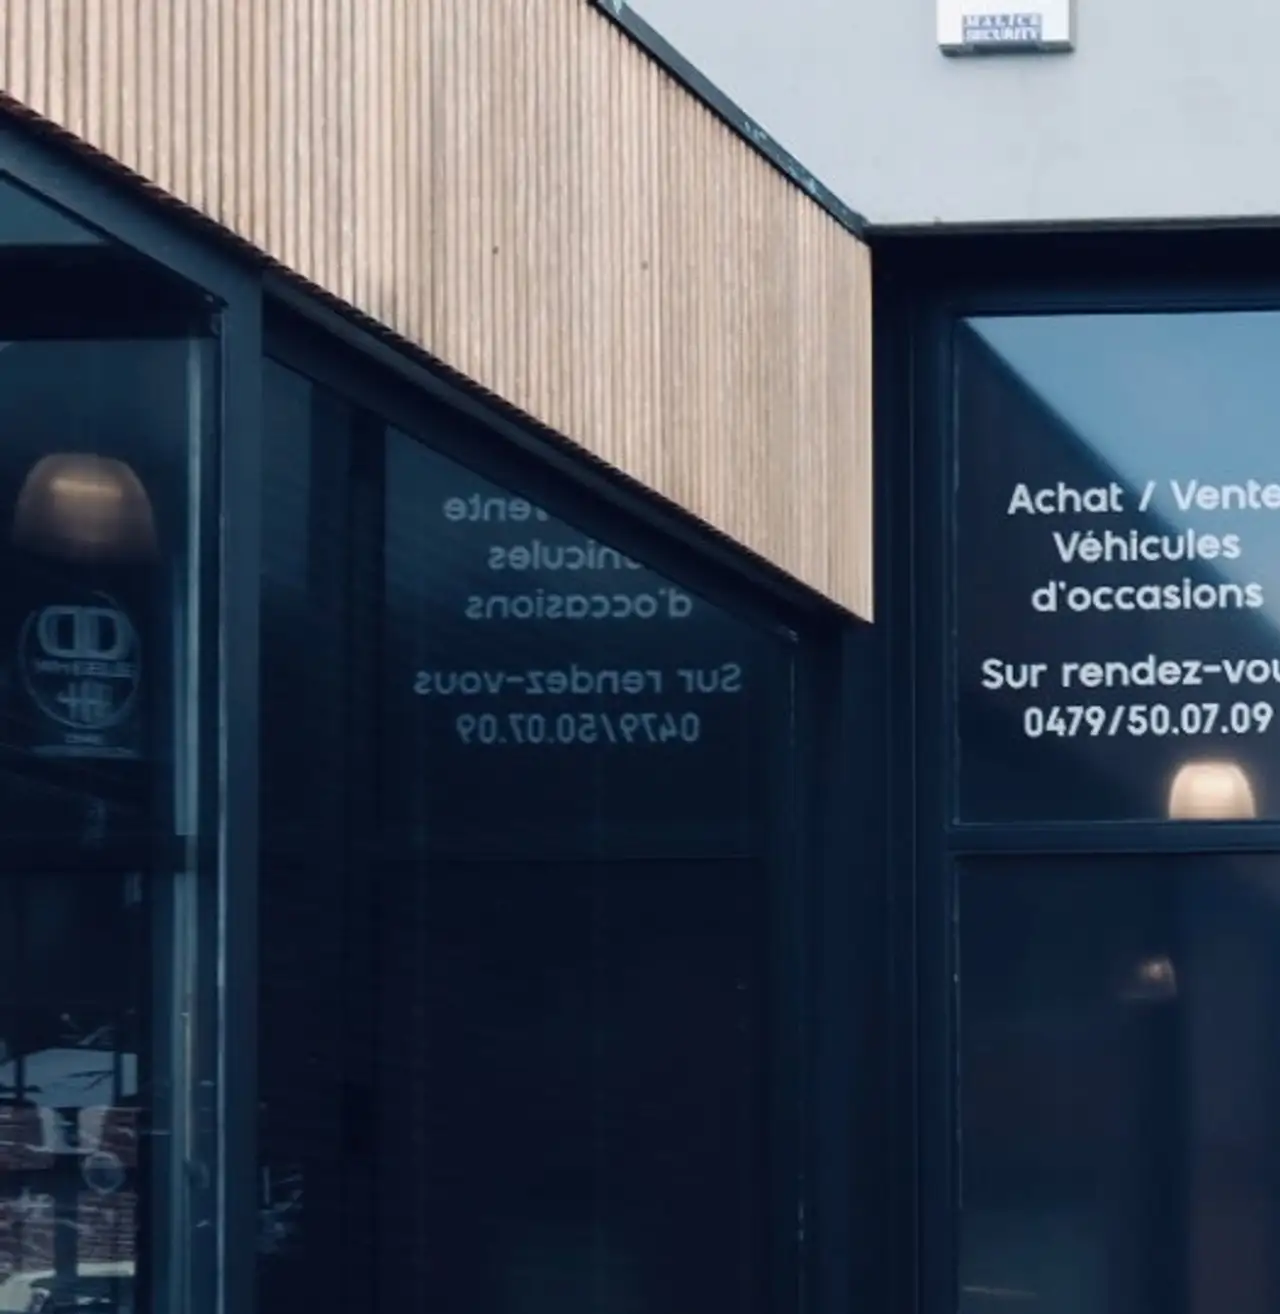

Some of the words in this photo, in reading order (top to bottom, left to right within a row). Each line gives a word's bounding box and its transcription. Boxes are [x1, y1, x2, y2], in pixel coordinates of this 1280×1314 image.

[1007, 481, 1123, 515] Achat
[1138, 480, 1157, 512] /
[1052, 527, 1242, 563] Véhicules
[1030, 577, 1265, 612] d'occasions
[981, 657, 1048, 690] Sur
[1023, 701, 1275, 739] 0479/50.07.09
